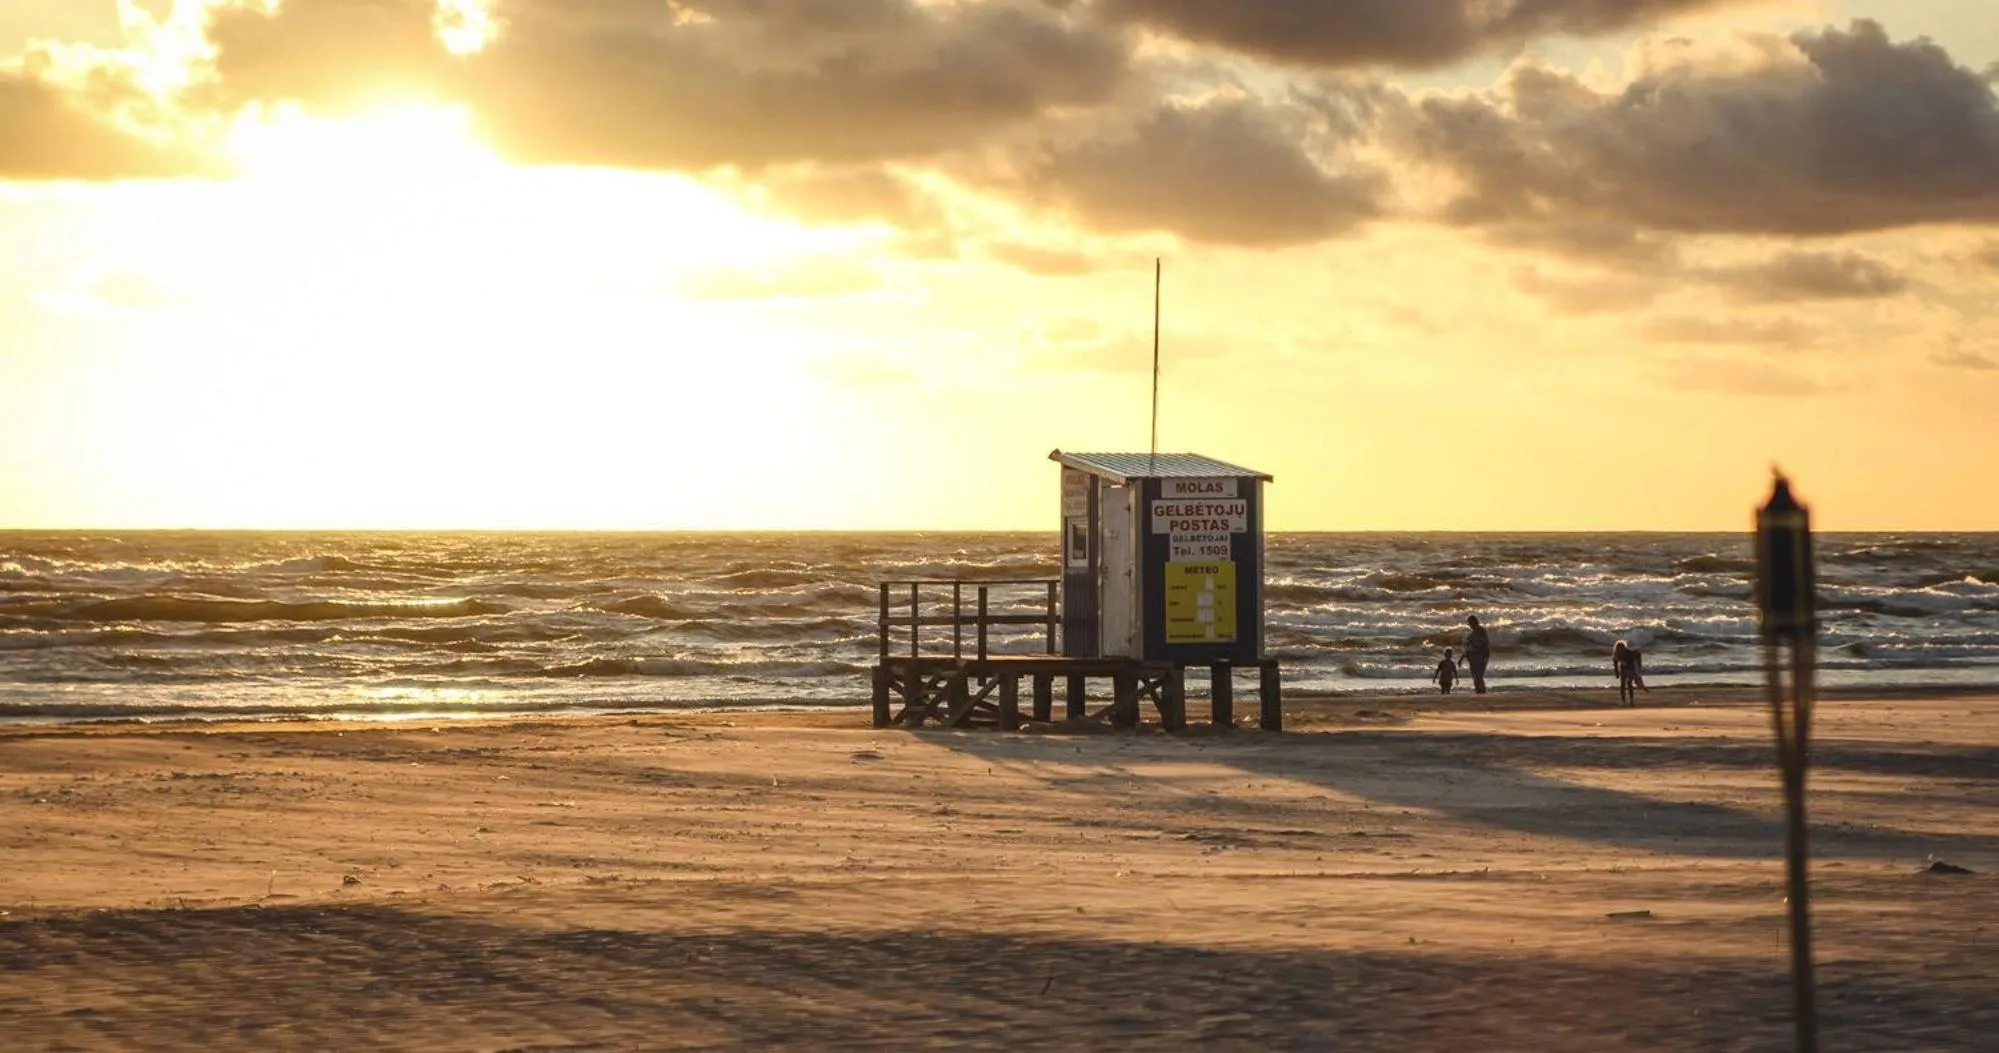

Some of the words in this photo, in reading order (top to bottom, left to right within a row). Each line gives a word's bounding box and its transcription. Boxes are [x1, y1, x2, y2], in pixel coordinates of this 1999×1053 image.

[1176, 482, 1224, 493] MOLAS
[1154, 502, 1245, 518] GELBĖTOJŲ
[1169, 520, 1230, 532] POSTAS
[1173, 546, 1195, 556] Tel.
[1200, 545, 1228, 555] 1509
[1184, 566, 1219, 574] METEO
